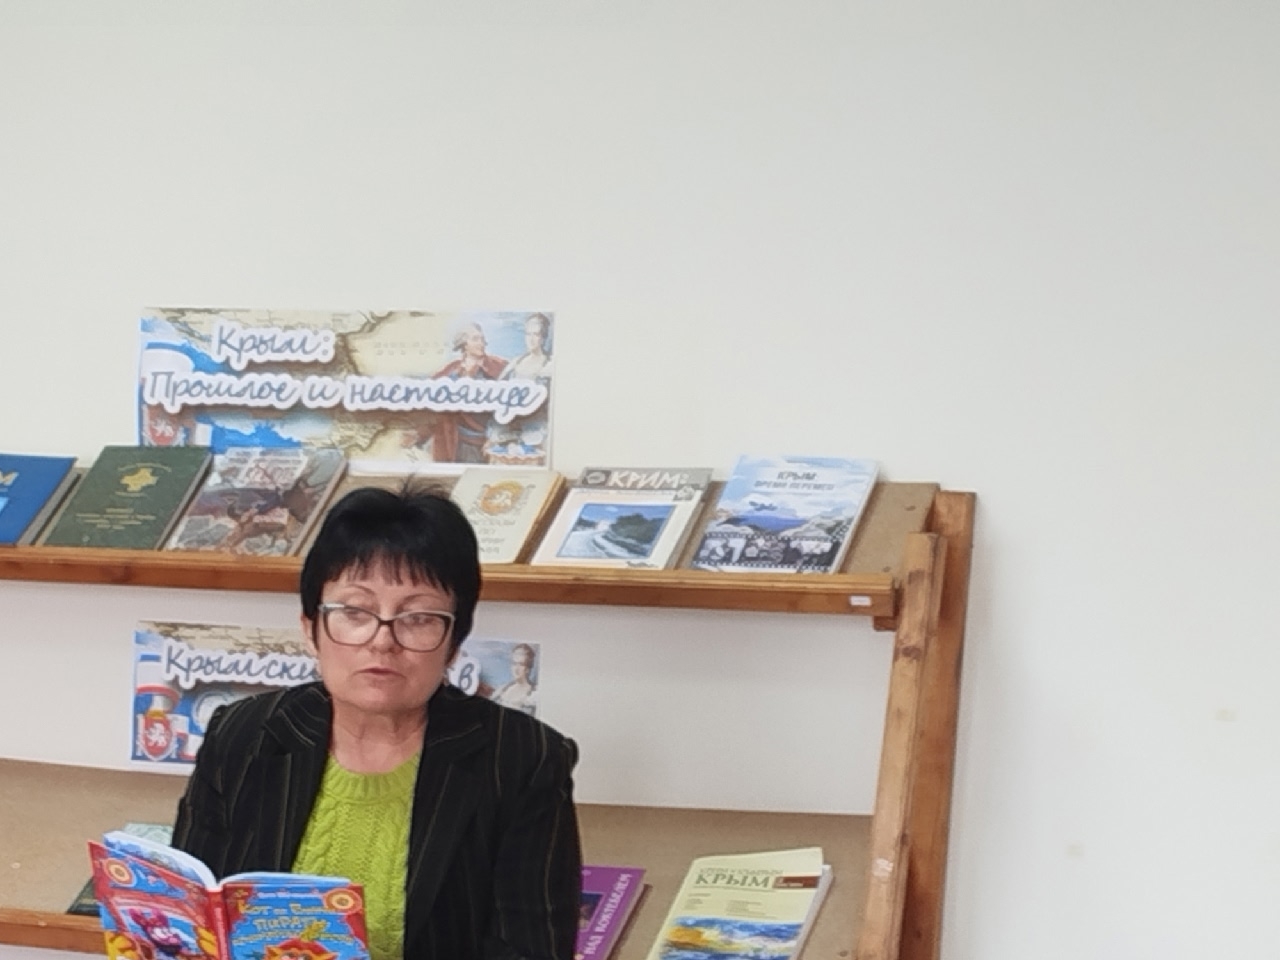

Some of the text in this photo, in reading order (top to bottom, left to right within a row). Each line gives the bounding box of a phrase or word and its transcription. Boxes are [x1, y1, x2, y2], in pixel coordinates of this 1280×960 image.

[216, 325, 332, 362] Крым:
[148, 370, 542, 416] Прошлое и настоящее
[165, 644, 322, 683] Крымски
[694, 873, 771, 889] КРЫМ
